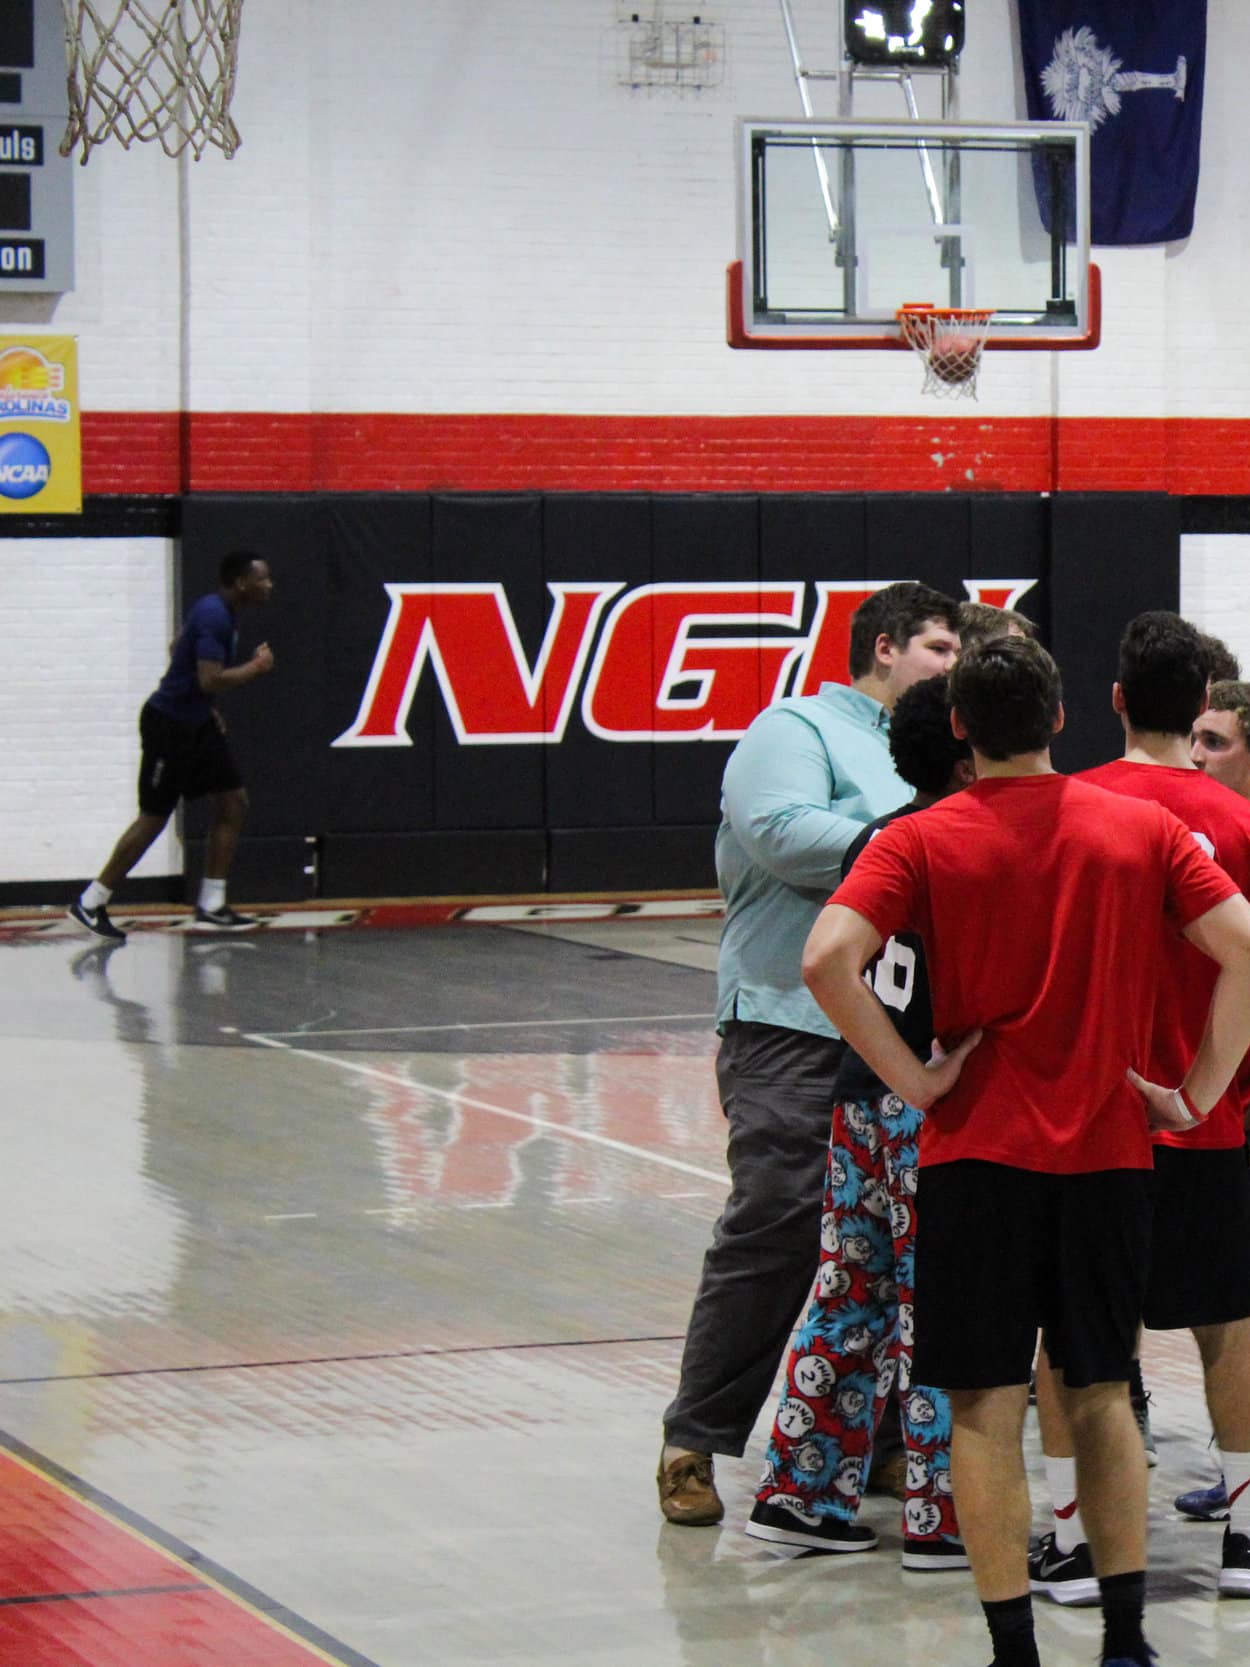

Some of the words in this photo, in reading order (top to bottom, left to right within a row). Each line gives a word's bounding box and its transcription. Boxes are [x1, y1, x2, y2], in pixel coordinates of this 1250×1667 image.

[801, 1370, 816, 1385] 2
[814, 1357, 832, 1395] THING
[784, 1415, 796, 1429] 1
